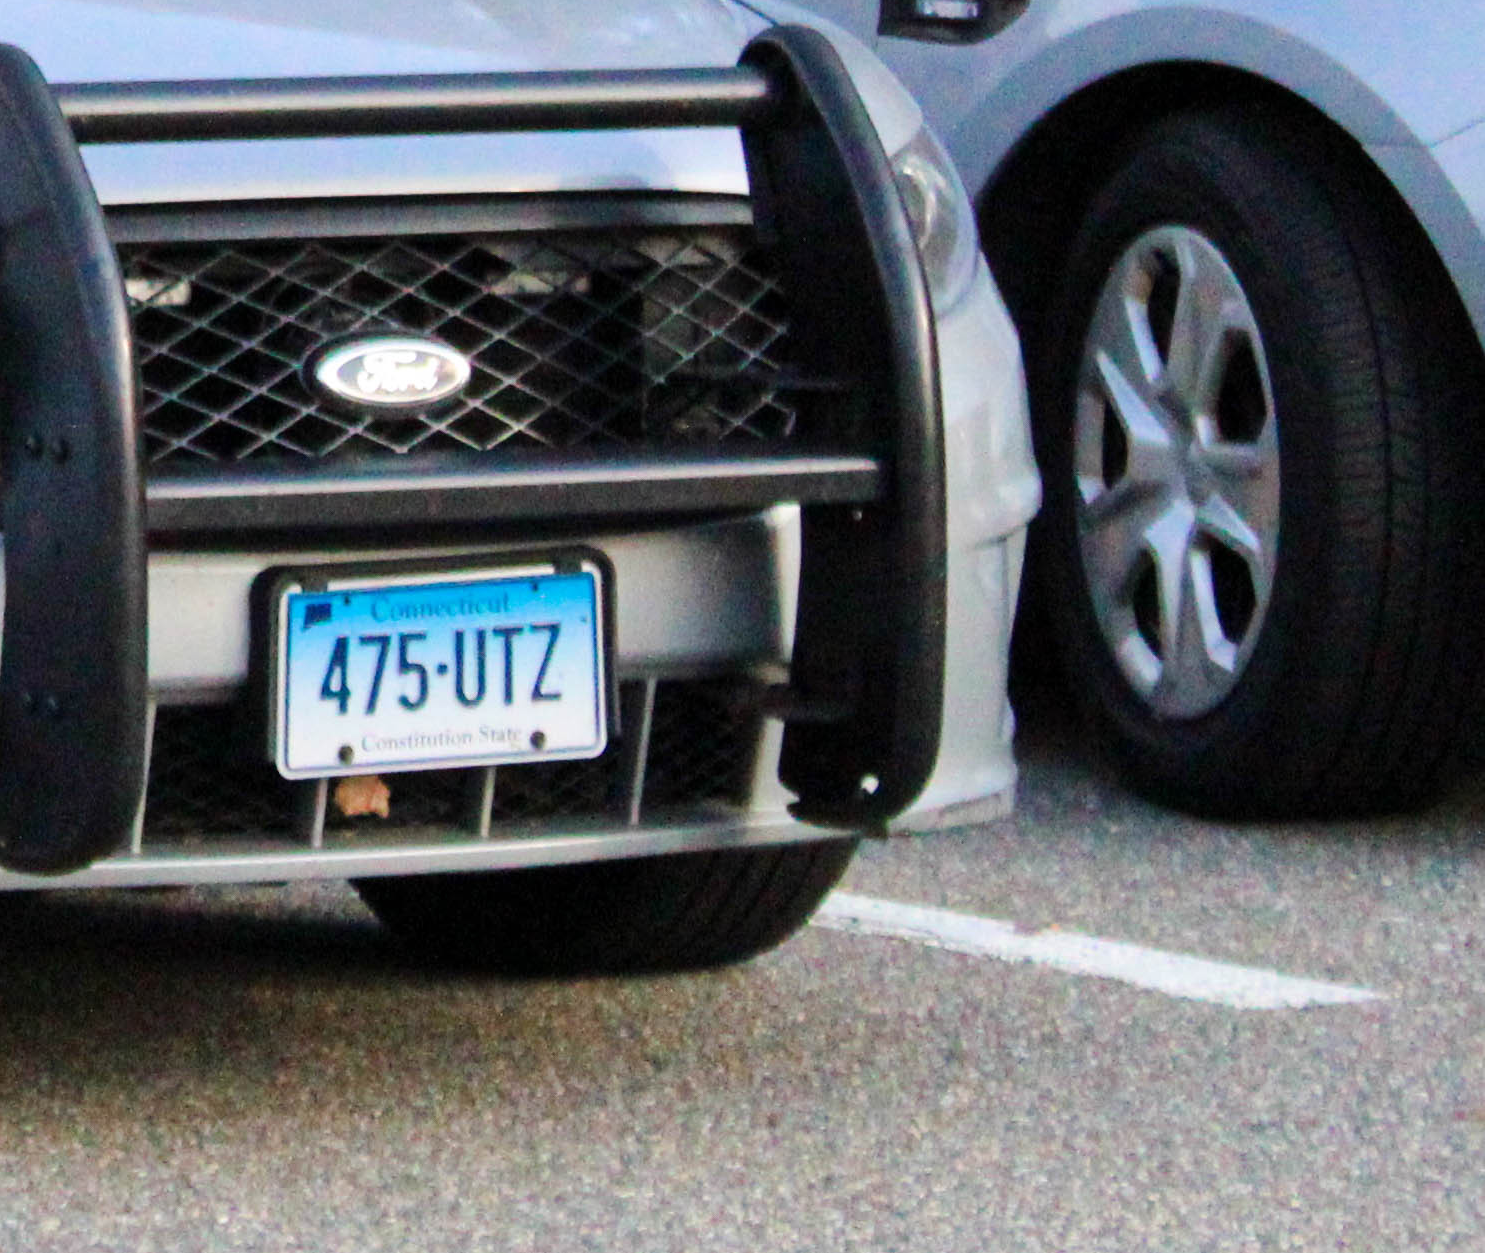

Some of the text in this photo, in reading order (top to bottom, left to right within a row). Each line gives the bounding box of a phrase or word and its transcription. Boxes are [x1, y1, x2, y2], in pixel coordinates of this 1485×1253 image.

[356, 350, 439, 393] Ford
[370, 593, 511, 622] Connecticut
[361, 724, 523, 753] Constitution State
